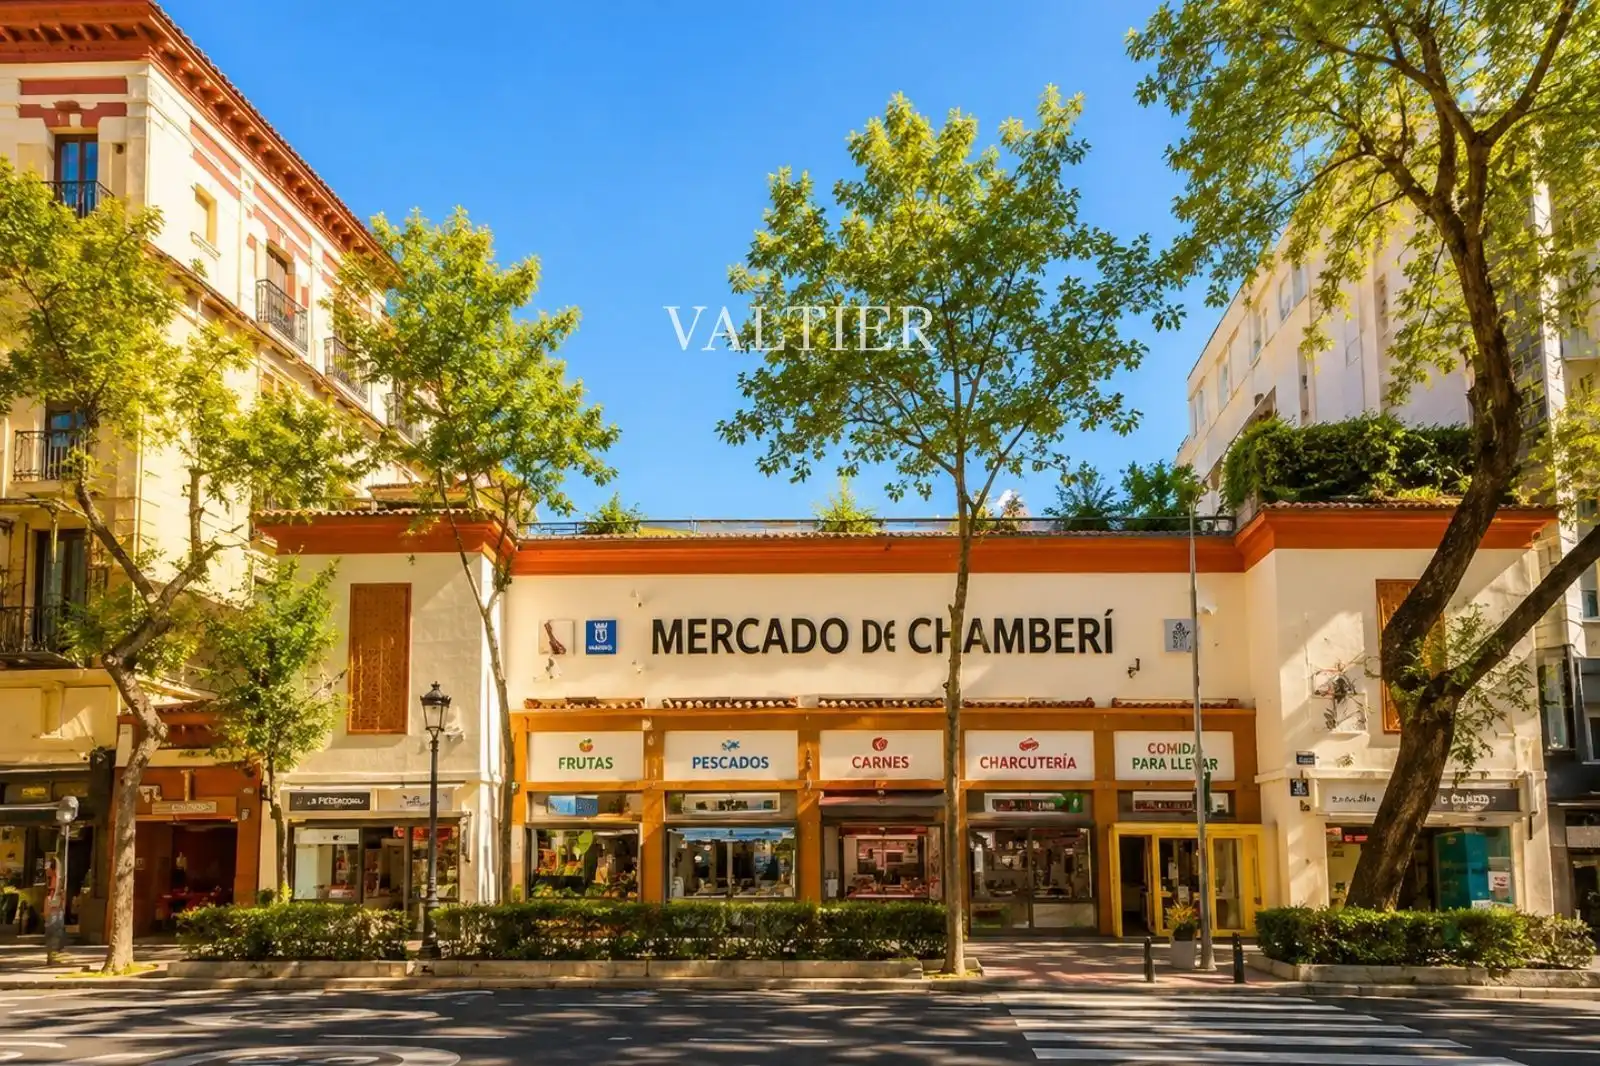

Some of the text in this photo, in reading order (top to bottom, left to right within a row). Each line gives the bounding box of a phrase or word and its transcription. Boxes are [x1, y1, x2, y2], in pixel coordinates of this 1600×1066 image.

[651, 609, 1114, 655] MERCADO DE CHAMBERÍ
[558, 756, 614, 770] FRUTAS
[692, 756, 769, 770] PESCADOS
[852, 755, 909, 769] CARNES
[980, 752, 1077, 769] CHARCUTERÍA
[1132, 757, 1168, 770] PARA
